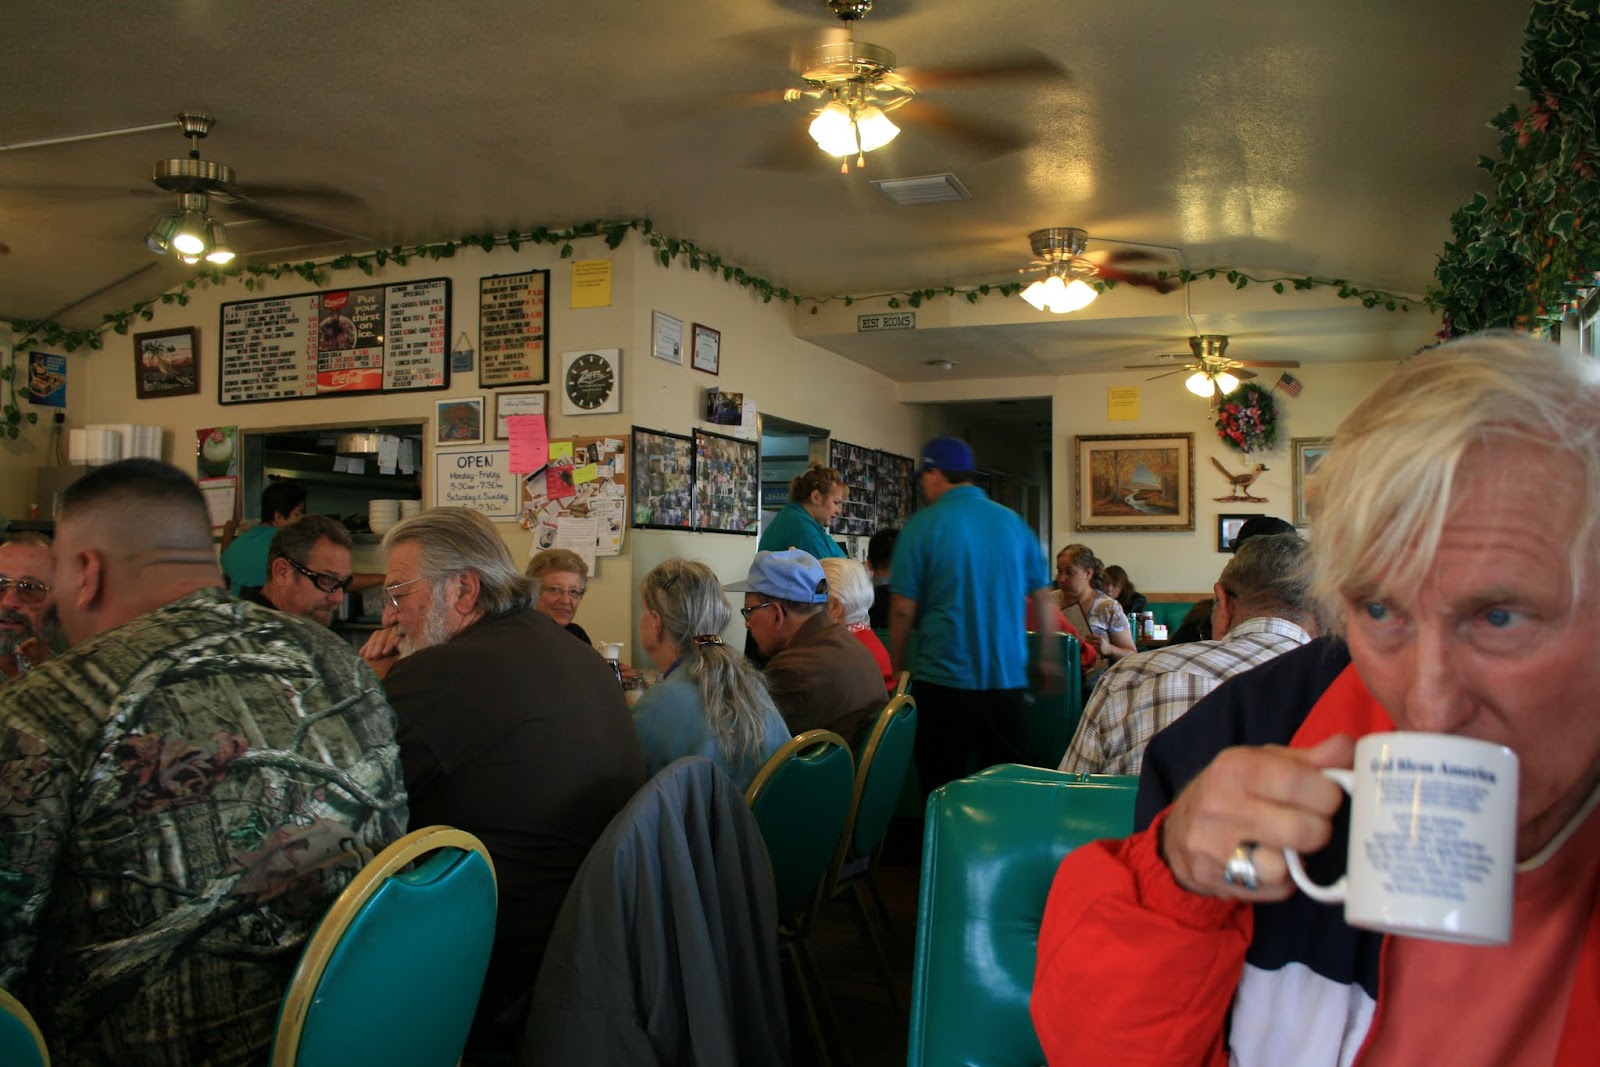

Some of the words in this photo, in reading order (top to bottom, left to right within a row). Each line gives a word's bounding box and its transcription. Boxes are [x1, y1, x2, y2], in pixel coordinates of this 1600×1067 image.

[357, 295, 376, 304] Put
[354, 304, 378, 314] your
[352, 313, 380, 322] thirst
[863, 318, 879, 328] REST
[883, 316, 910, 327] ROOMS
[458, 454, 493, 468] OPEN
